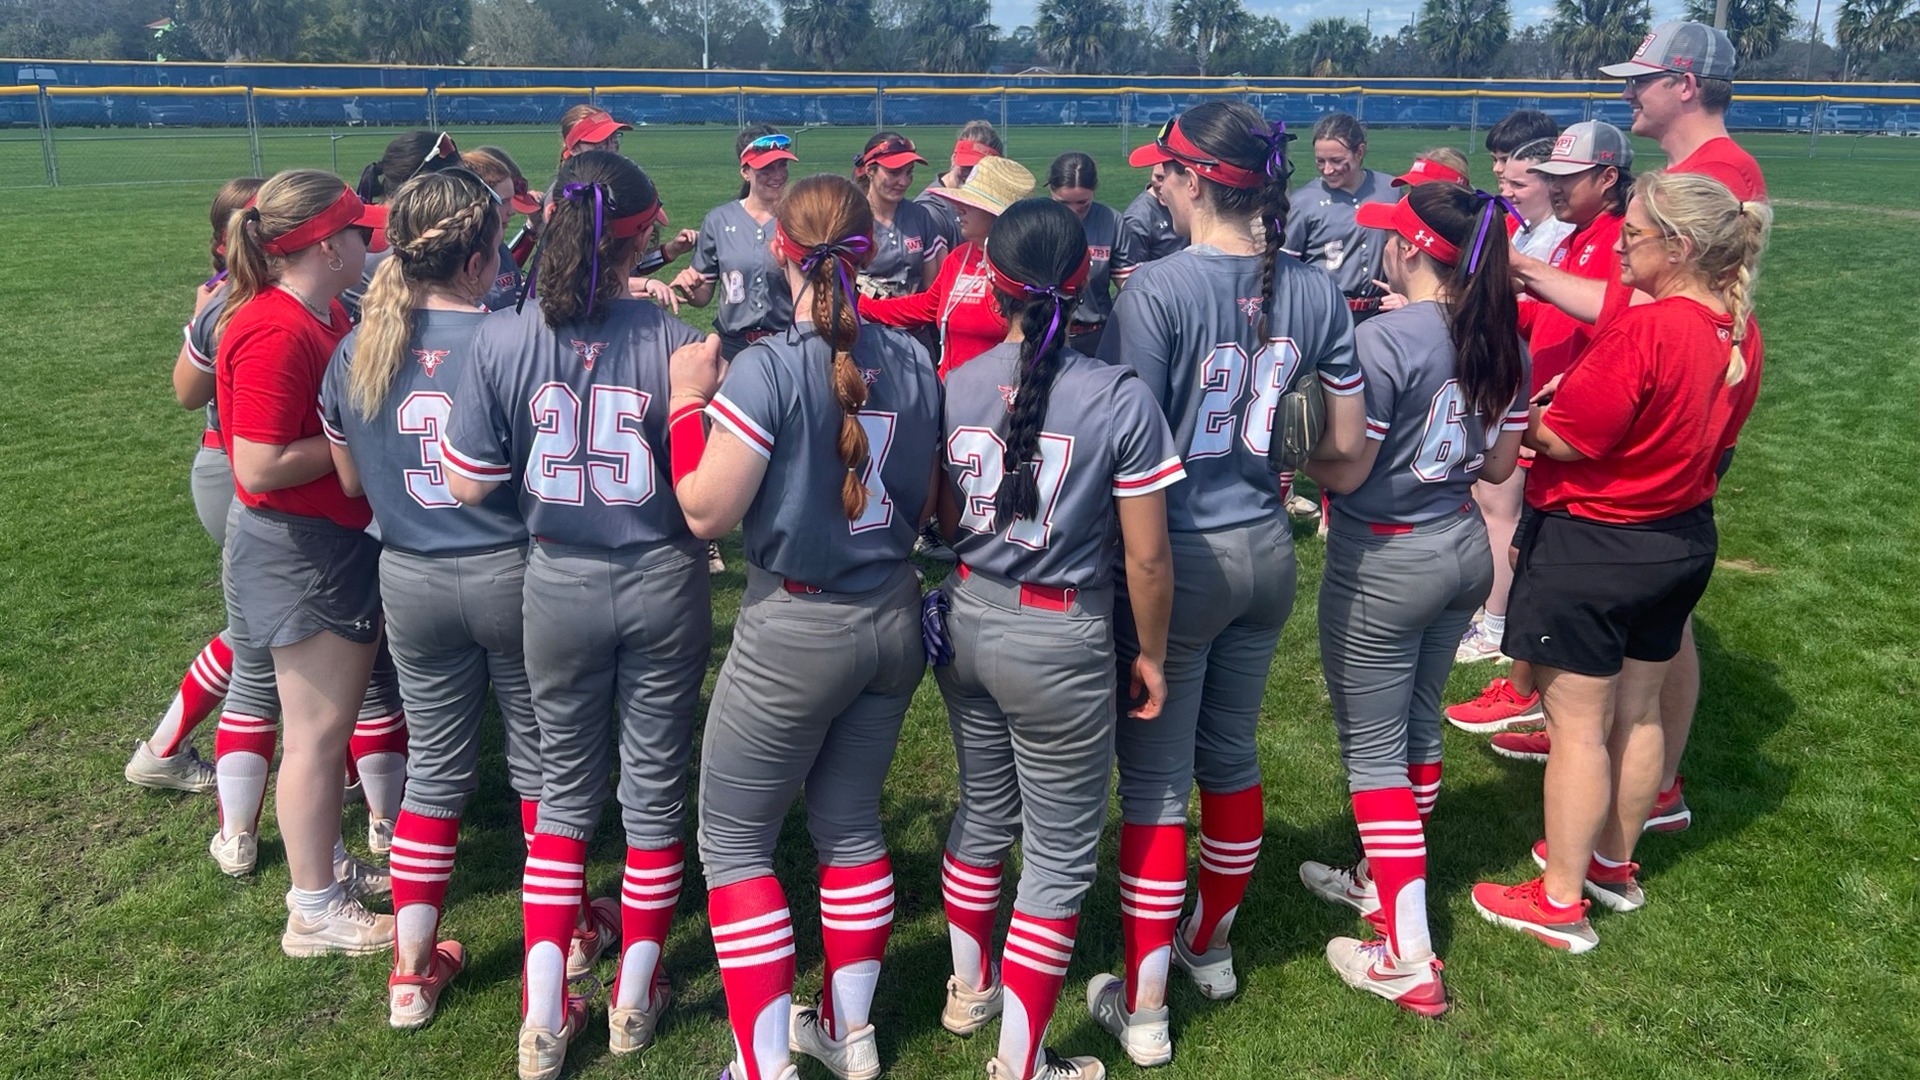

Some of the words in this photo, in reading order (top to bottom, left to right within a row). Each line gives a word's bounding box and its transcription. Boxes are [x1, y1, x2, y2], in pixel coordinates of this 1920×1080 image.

[1324, 240, 1344, 270] 5
[397, 390, 463, 509] 3
[524, 381, 656, 507] 25
[1186, 336, 1301, 462] 28
[948, 425, 1075, 551] 27
